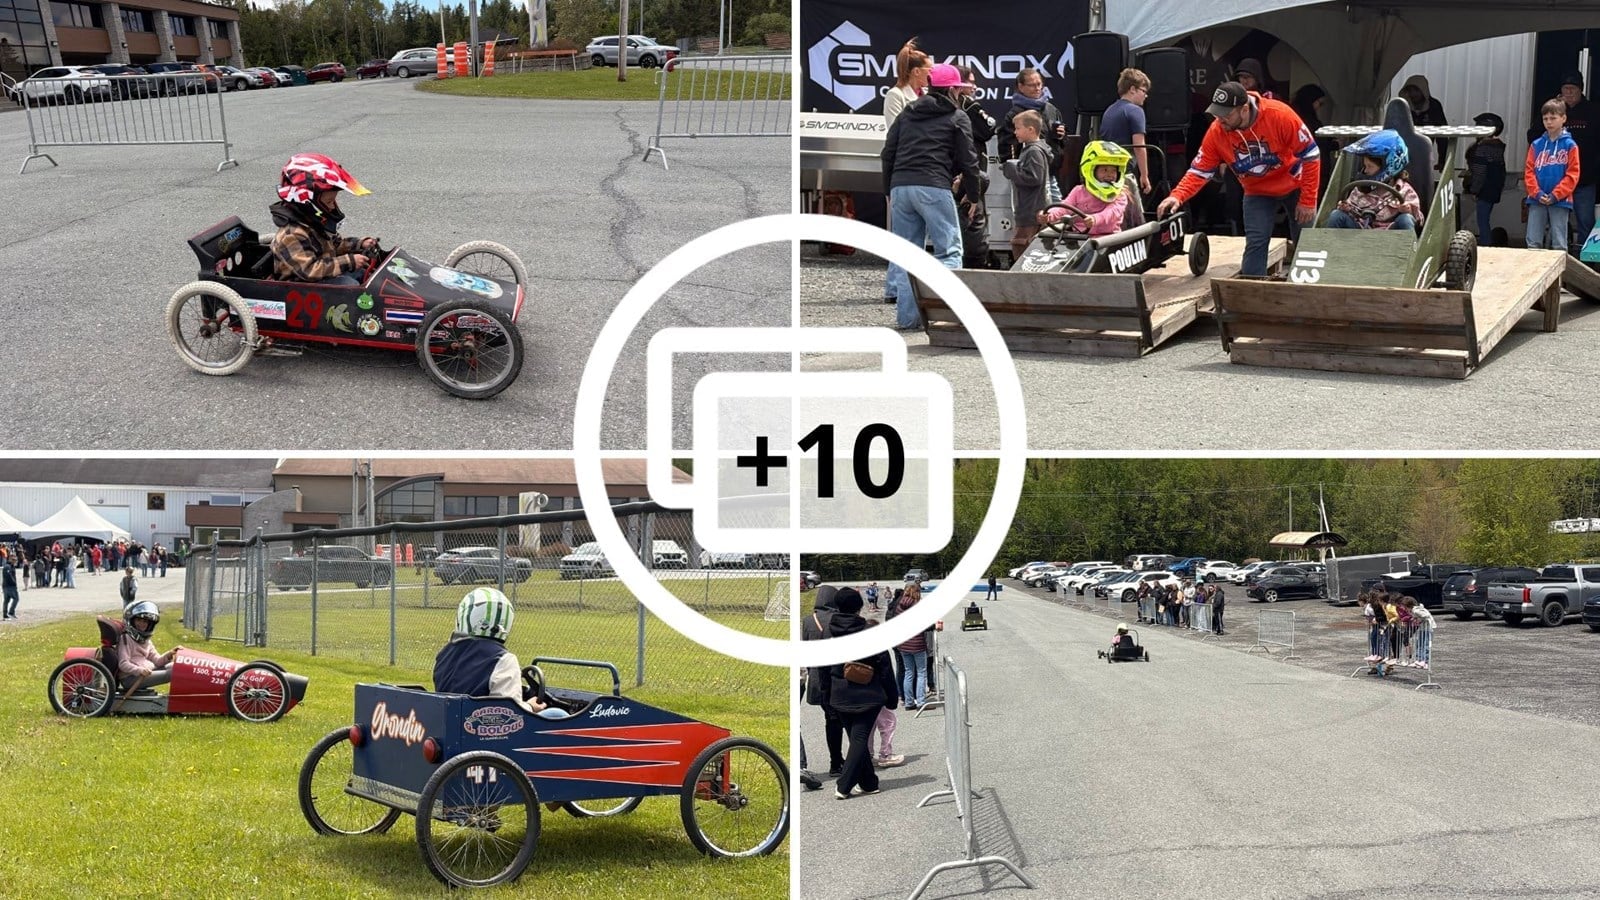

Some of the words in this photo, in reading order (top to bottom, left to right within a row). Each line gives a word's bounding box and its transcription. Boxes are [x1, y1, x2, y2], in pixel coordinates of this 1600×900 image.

[837, 53, 1053, 79] SMINOX
[805, 121, 878, 131] SMOKINOX
[1440, 179, 1454, 218] 113
[1169, 217, 1184, 241] 01
[1108, 239, 1147, 274] POULIN
[1291, 250, 1328, 284] 113
[285, 289, 324, 330] 29
[176, 655, 232, 672] BOUTIQUE
[249, 675, 265, 683] Golf
[472, 707, 515, 718] GARAGE
[589, 703, 630, 719] Ludovic
[371, 700, 426, 747] Grondin
[478, 719, 524, 736] BOLDUC
